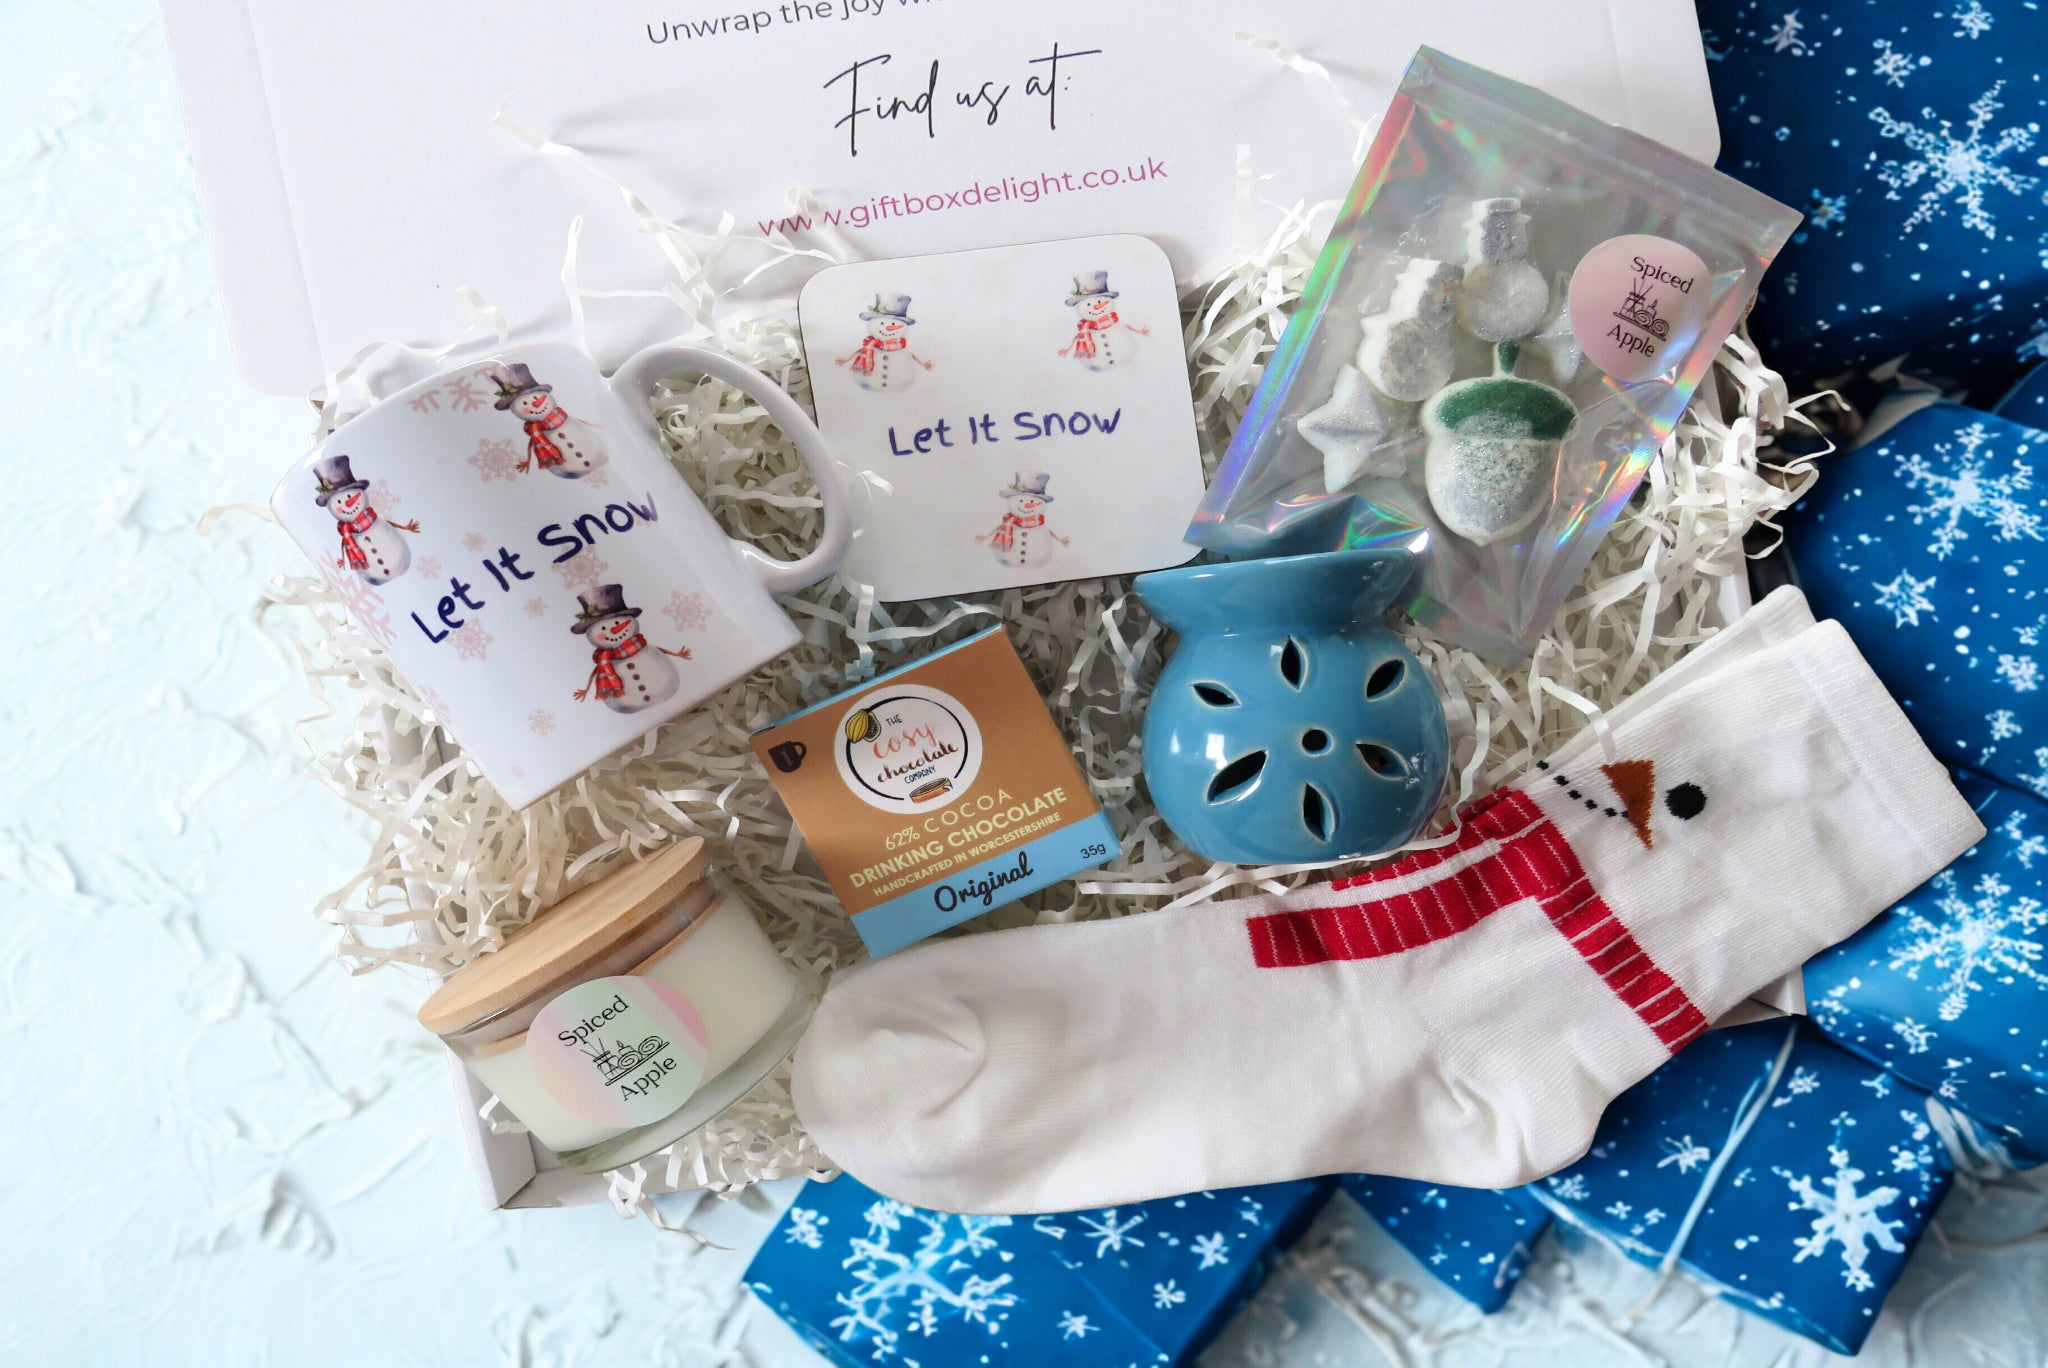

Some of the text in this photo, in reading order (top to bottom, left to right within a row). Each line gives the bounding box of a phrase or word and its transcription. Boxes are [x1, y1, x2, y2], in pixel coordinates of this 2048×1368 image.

[647, 9, 772, 46] Unwrap
[779, 0, 833, 24] the
[823, 42, 1102, 157] Find us at:
[758, 156, 1168, 239] www.giftboxdelight.co.uk
[1630, 256, 1695, 295] Spiced
[1606, 323, 1655, 358] Apple
[888, 418, 954, 456] Let
[968, 413, 1000, 445] It
[411, 576, 486, 644] Let
[482, 546, 535, 593] It
[885, 714, 903, 727] THE
[877, 740, 959, 783] chocolate
[904, 764, 937, 785] COMPANY
[849, 786, 1069, 888] DRINKING CHOCOLATE
[885, 788, 1013, 851] 62% COCOA
[872, 811, 1063, 898] HANDCRAFTED IN WORCESTERSHIRE
[1080, 841, 1107, 860] 35g
[933, 850, 1035, 913] Original
[557, 994, 631, 1047] Spiced
[619, 1056, 678, 1102] Apple
